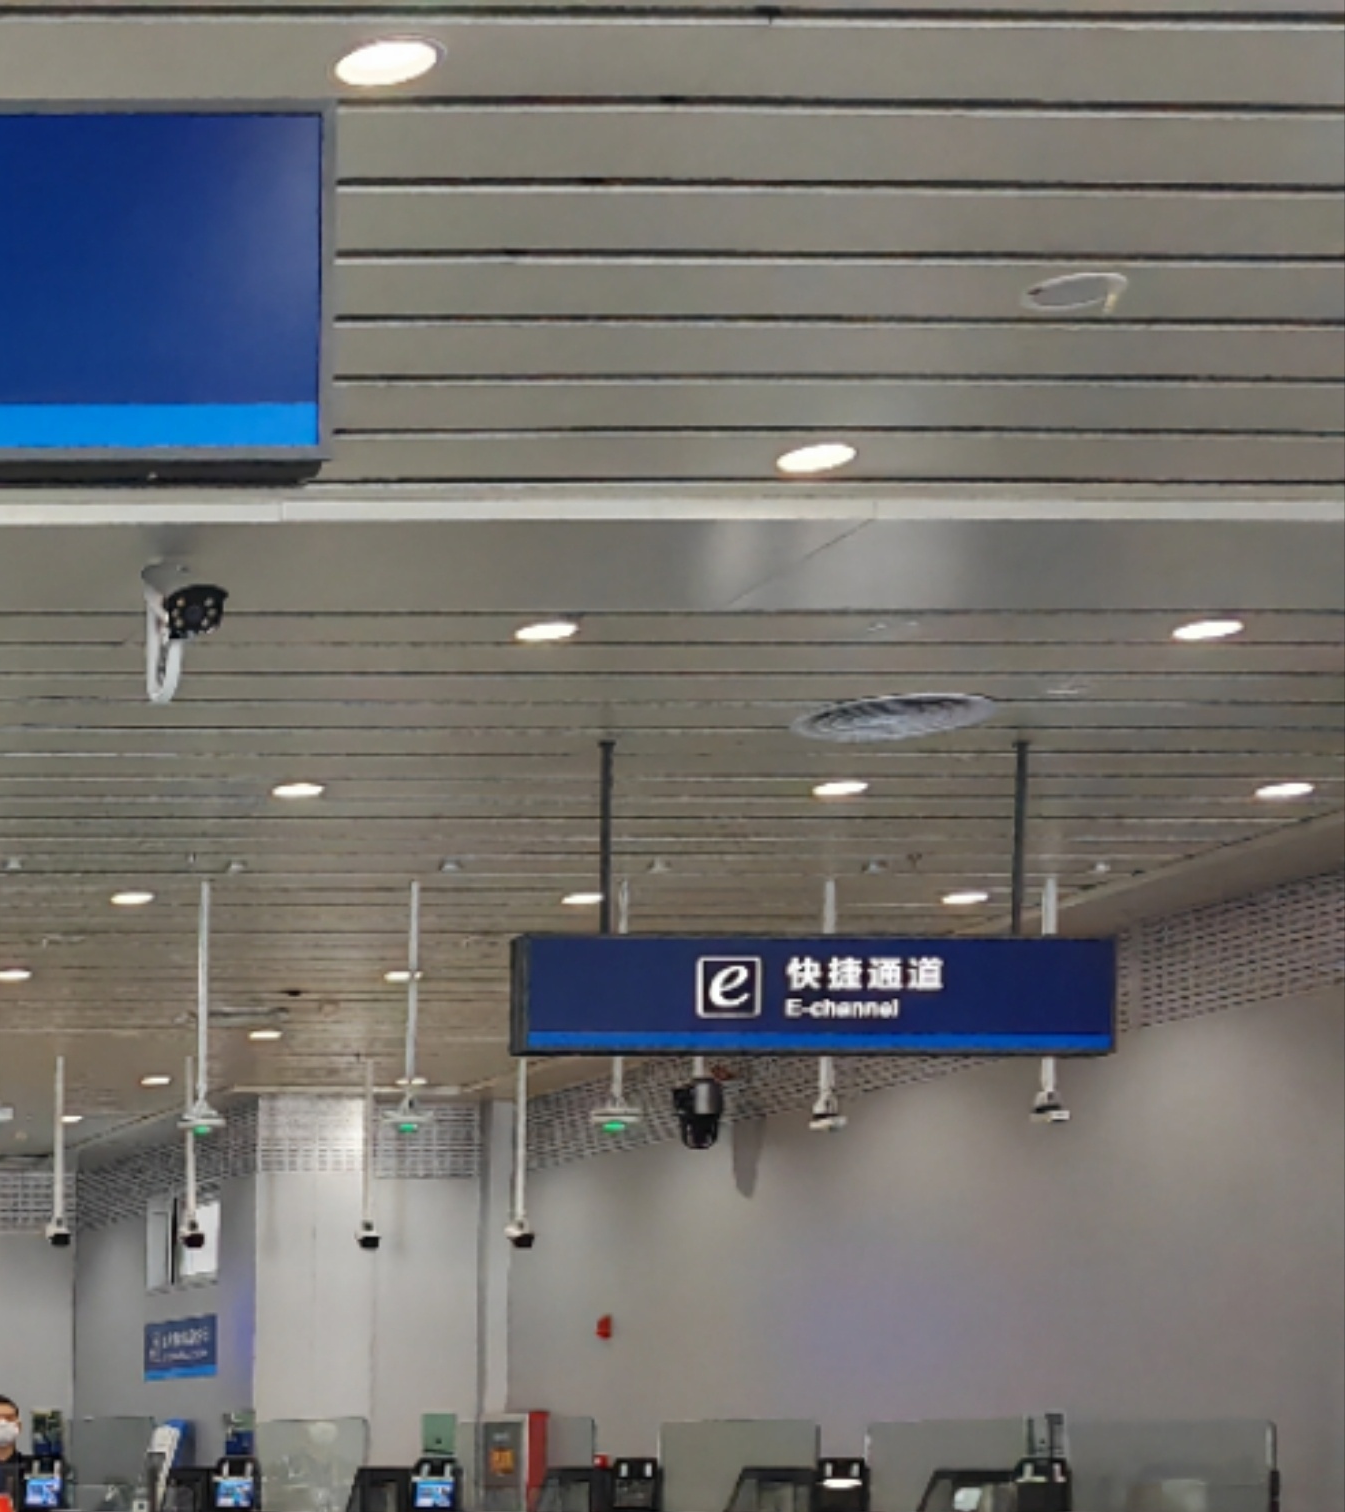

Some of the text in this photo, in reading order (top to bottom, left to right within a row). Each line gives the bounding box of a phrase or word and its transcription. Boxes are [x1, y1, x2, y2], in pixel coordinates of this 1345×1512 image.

[786, 957, 944, 991] 快捷通道
[784, 998, 900, 1019] E-channel
